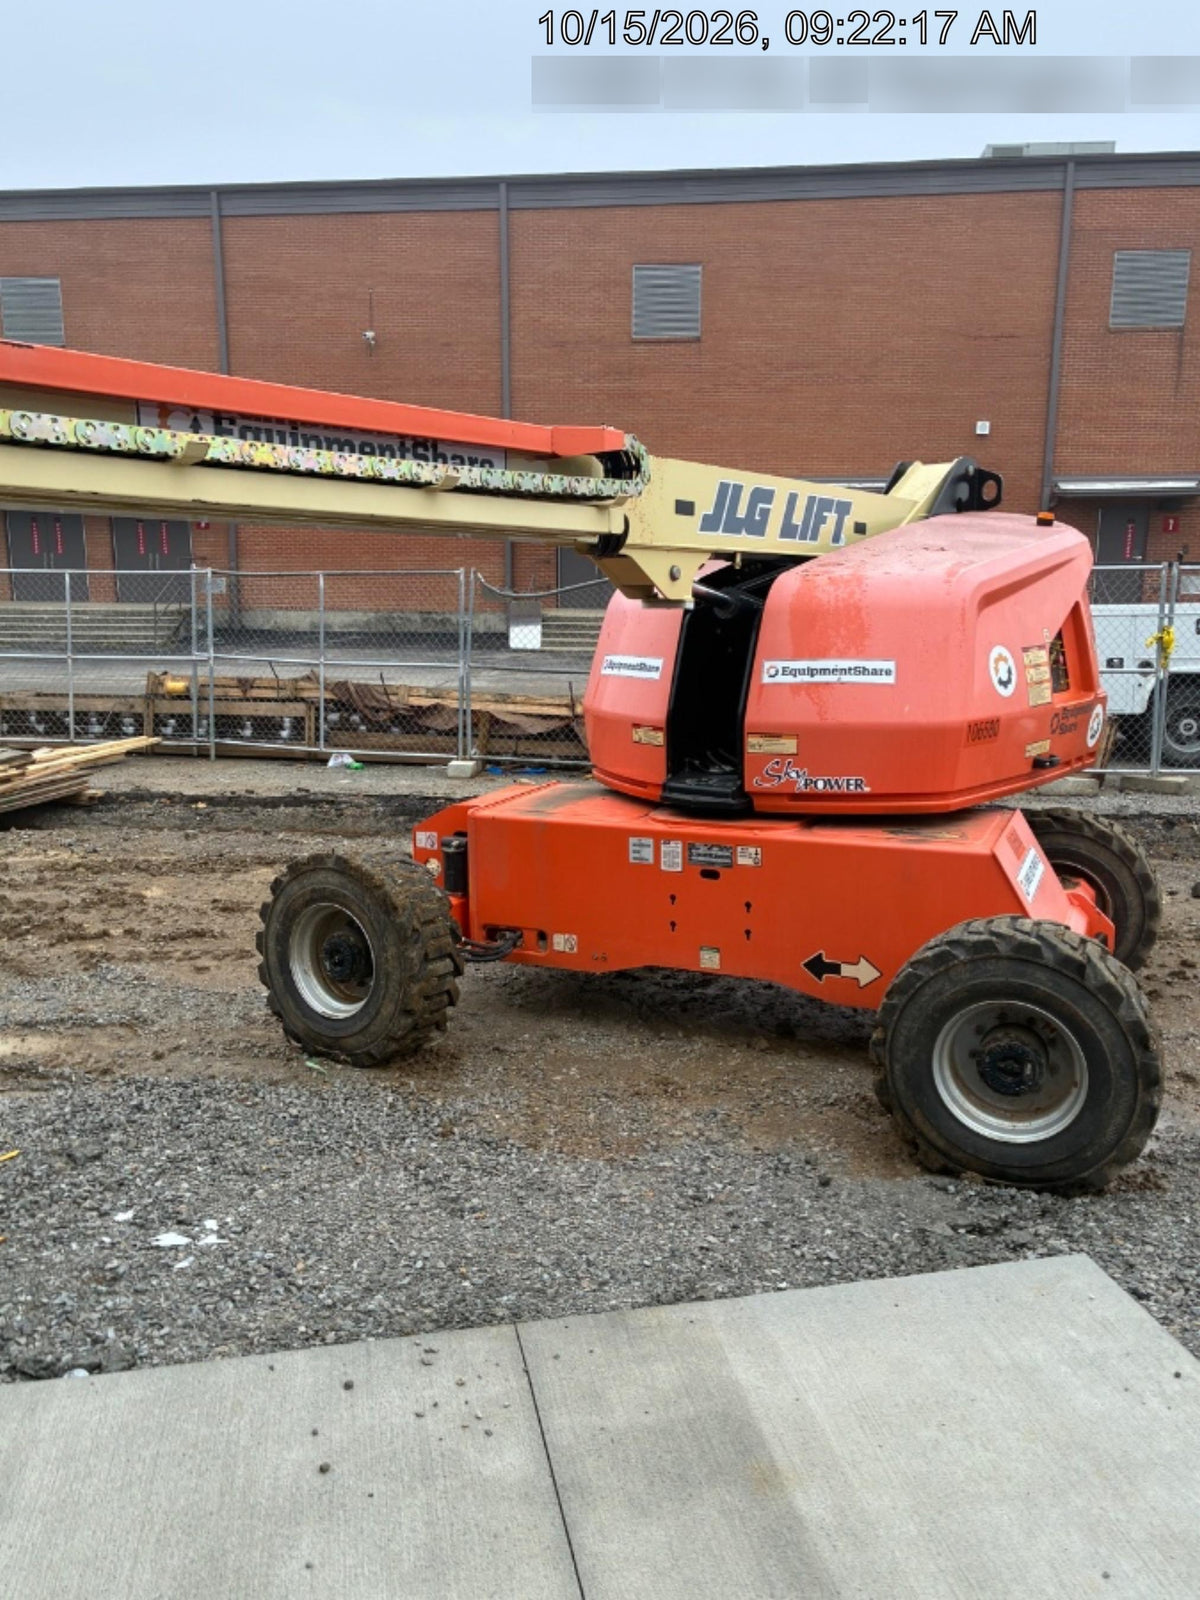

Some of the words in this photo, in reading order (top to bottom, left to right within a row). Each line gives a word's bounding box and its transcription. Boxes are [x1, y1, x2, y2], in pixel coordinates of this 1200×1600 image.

[698, 479, 776, 538] JLG
[777, 489, 854, 546] LIFT
[781, 666, 893, 679] EquipmentShare
[803, 777, 866, 792] POWER
